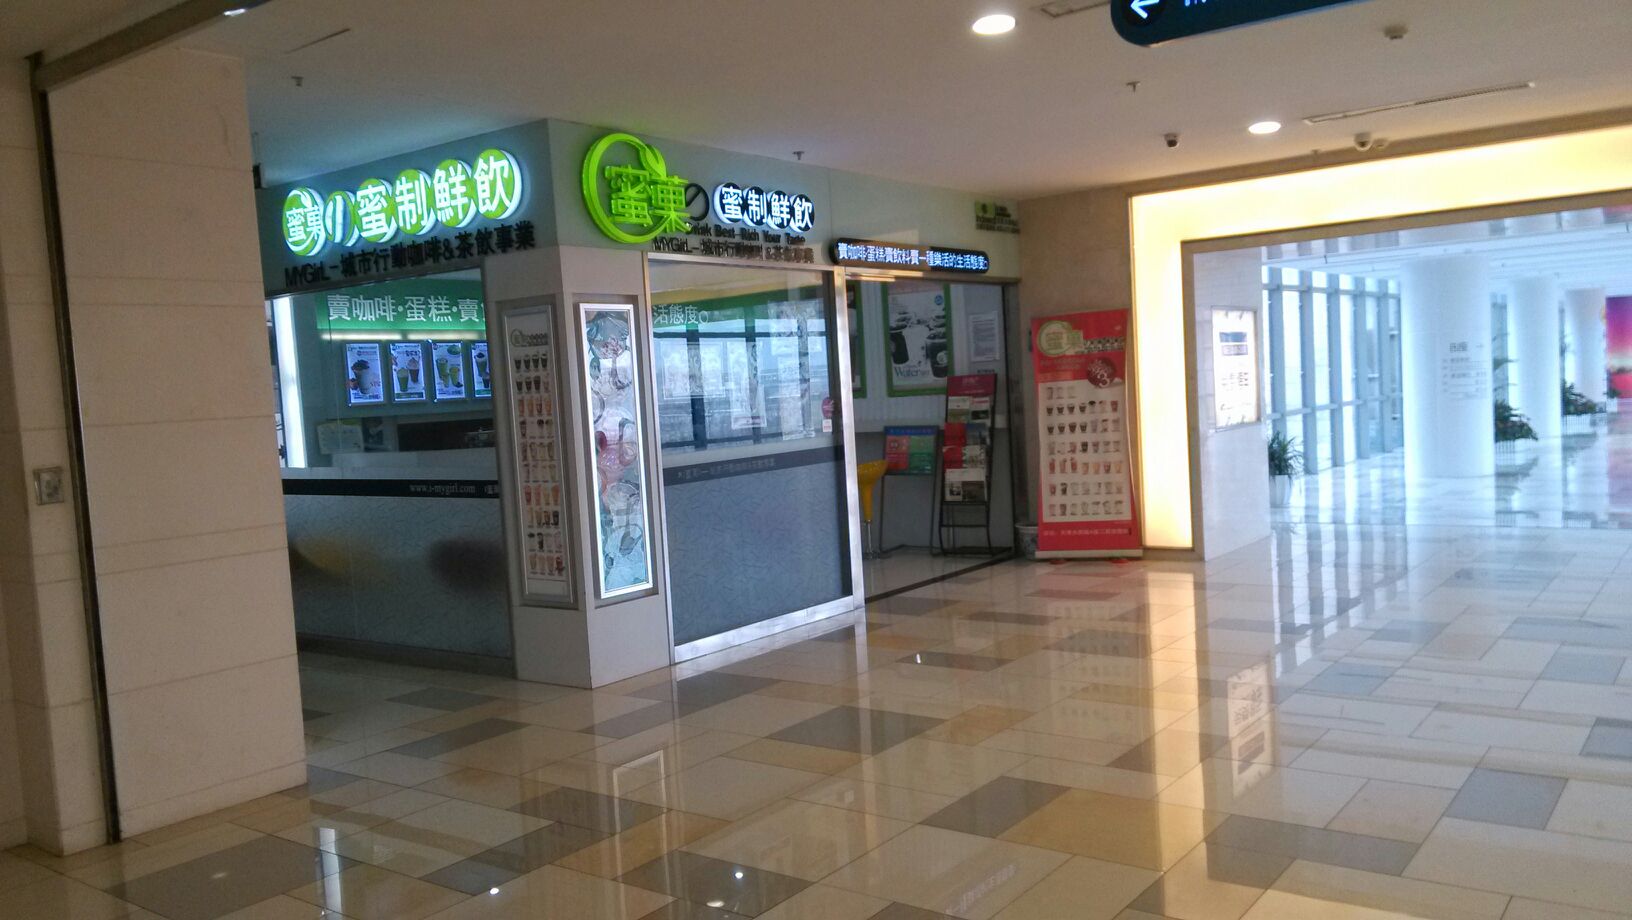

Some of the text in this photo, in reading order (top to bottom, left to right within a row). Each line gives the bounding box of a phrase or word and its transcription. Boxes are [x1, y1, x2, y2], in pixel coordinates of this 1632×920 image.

[356, 155, 510, 239] 蜜制鮮飲
[720, 185, 814, 230] 蜜制鮮飲
